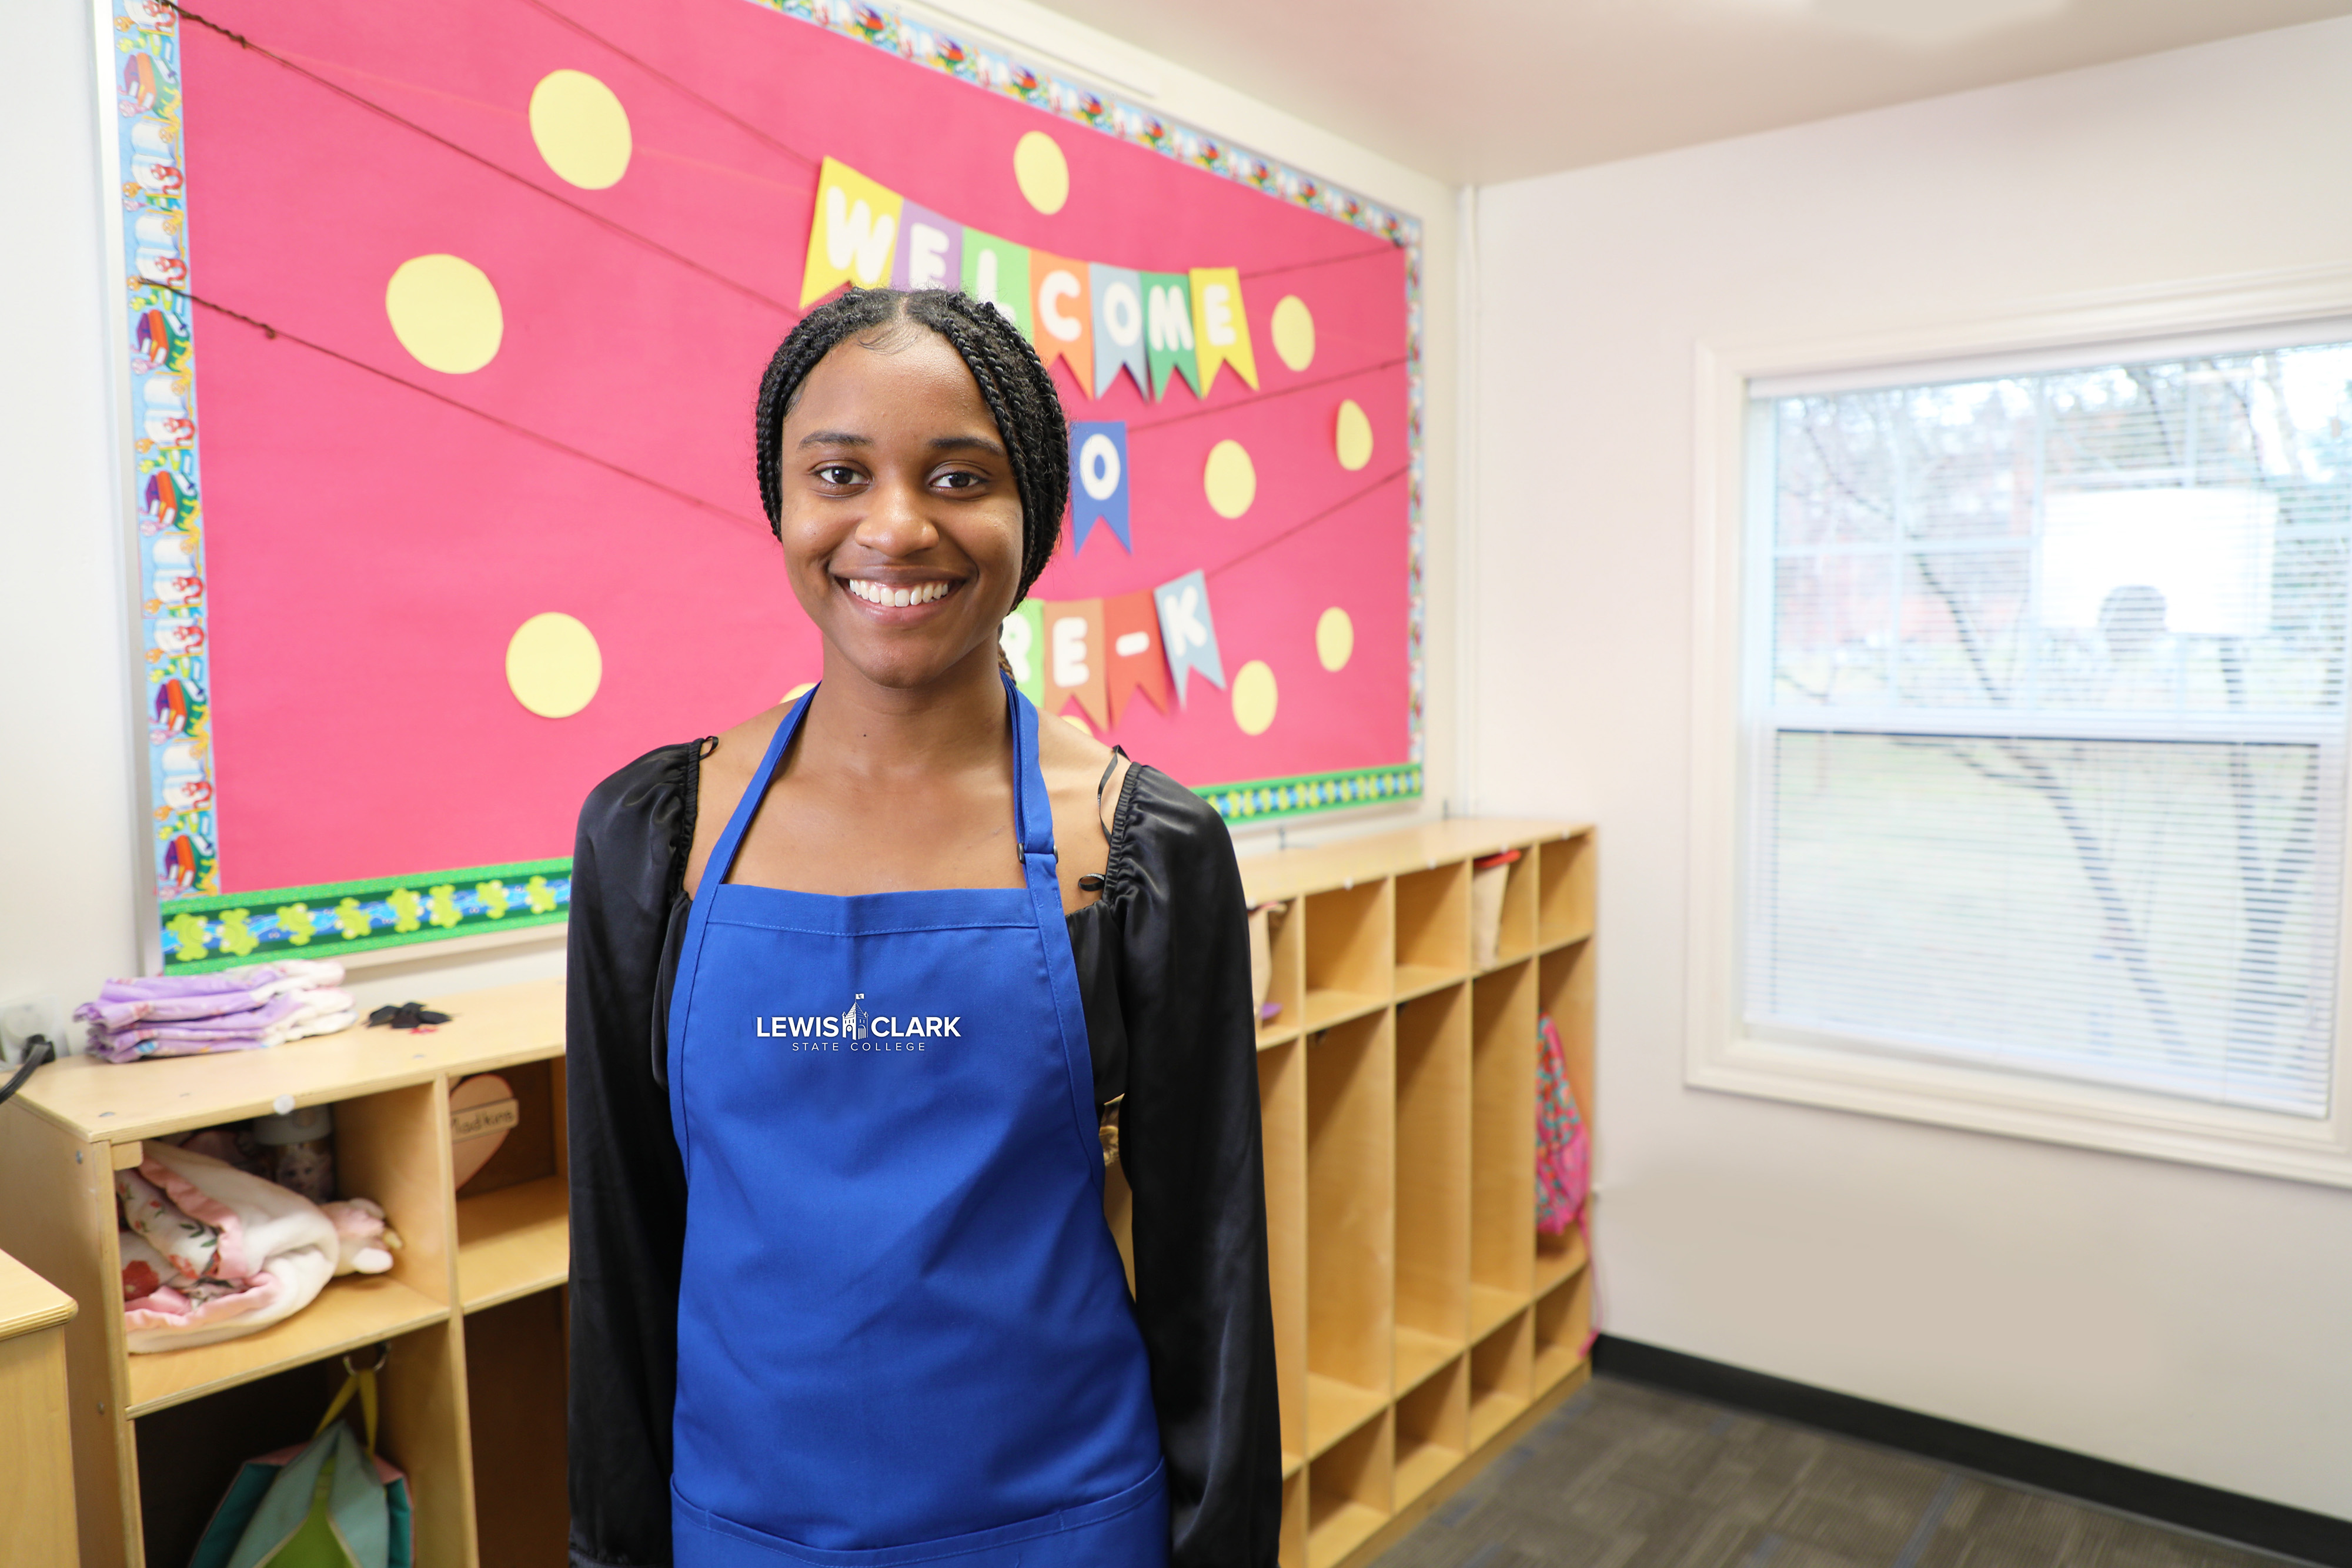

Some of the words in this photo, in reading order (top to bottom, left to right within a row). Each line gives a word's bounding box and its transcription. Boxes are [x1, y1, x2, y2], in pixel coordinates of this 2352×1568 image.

[826, 186, 1236, 352] WELCOME
[1080, 433, 1121, 501] O
[999, 586, 1208, 688] RE-K
[756, 1017, 839, 1038] LEWIS
[871, 1017, 961, 1038] CLARK
[792, 1042, 839, 1051] STATE
[850, 1042, 926, 1051] COLLEGE
